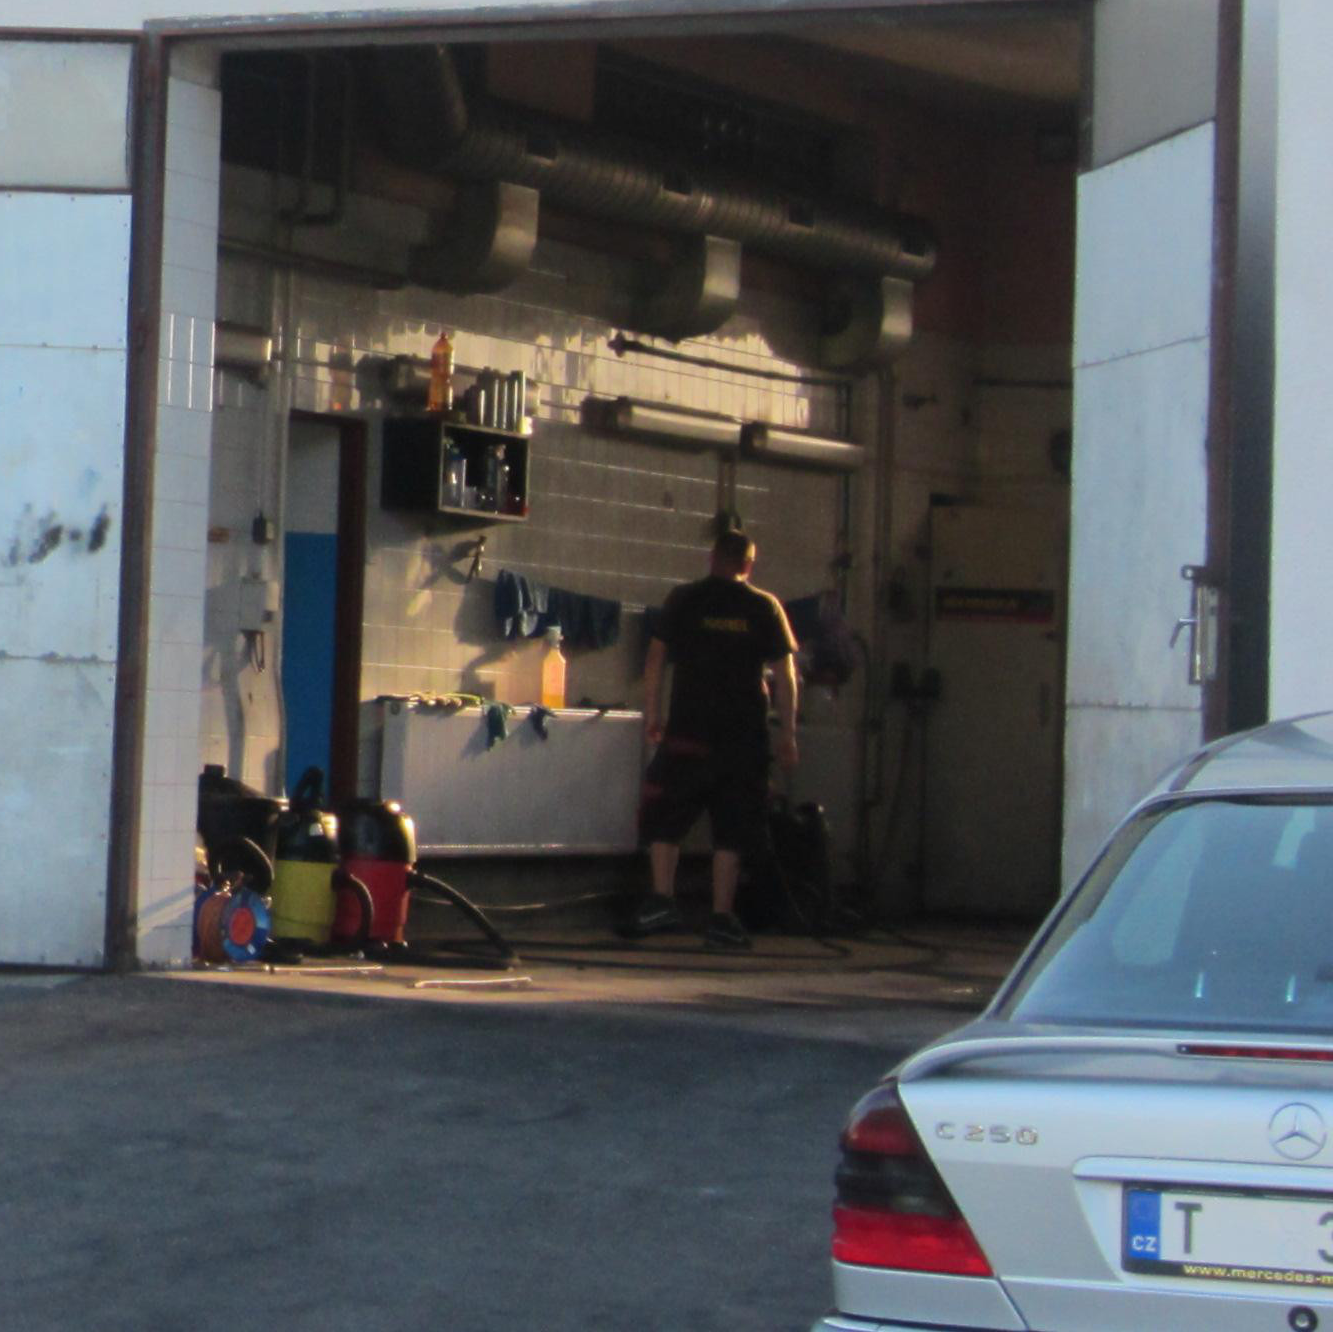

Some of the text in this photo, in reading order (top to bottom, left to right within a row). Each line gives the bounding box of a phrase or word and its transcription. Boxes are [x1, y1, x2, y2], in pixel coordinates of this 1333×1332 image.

[935, 1121, 1039, 1146] C 250
[1131, 1234, 1158, 1253] CZ
